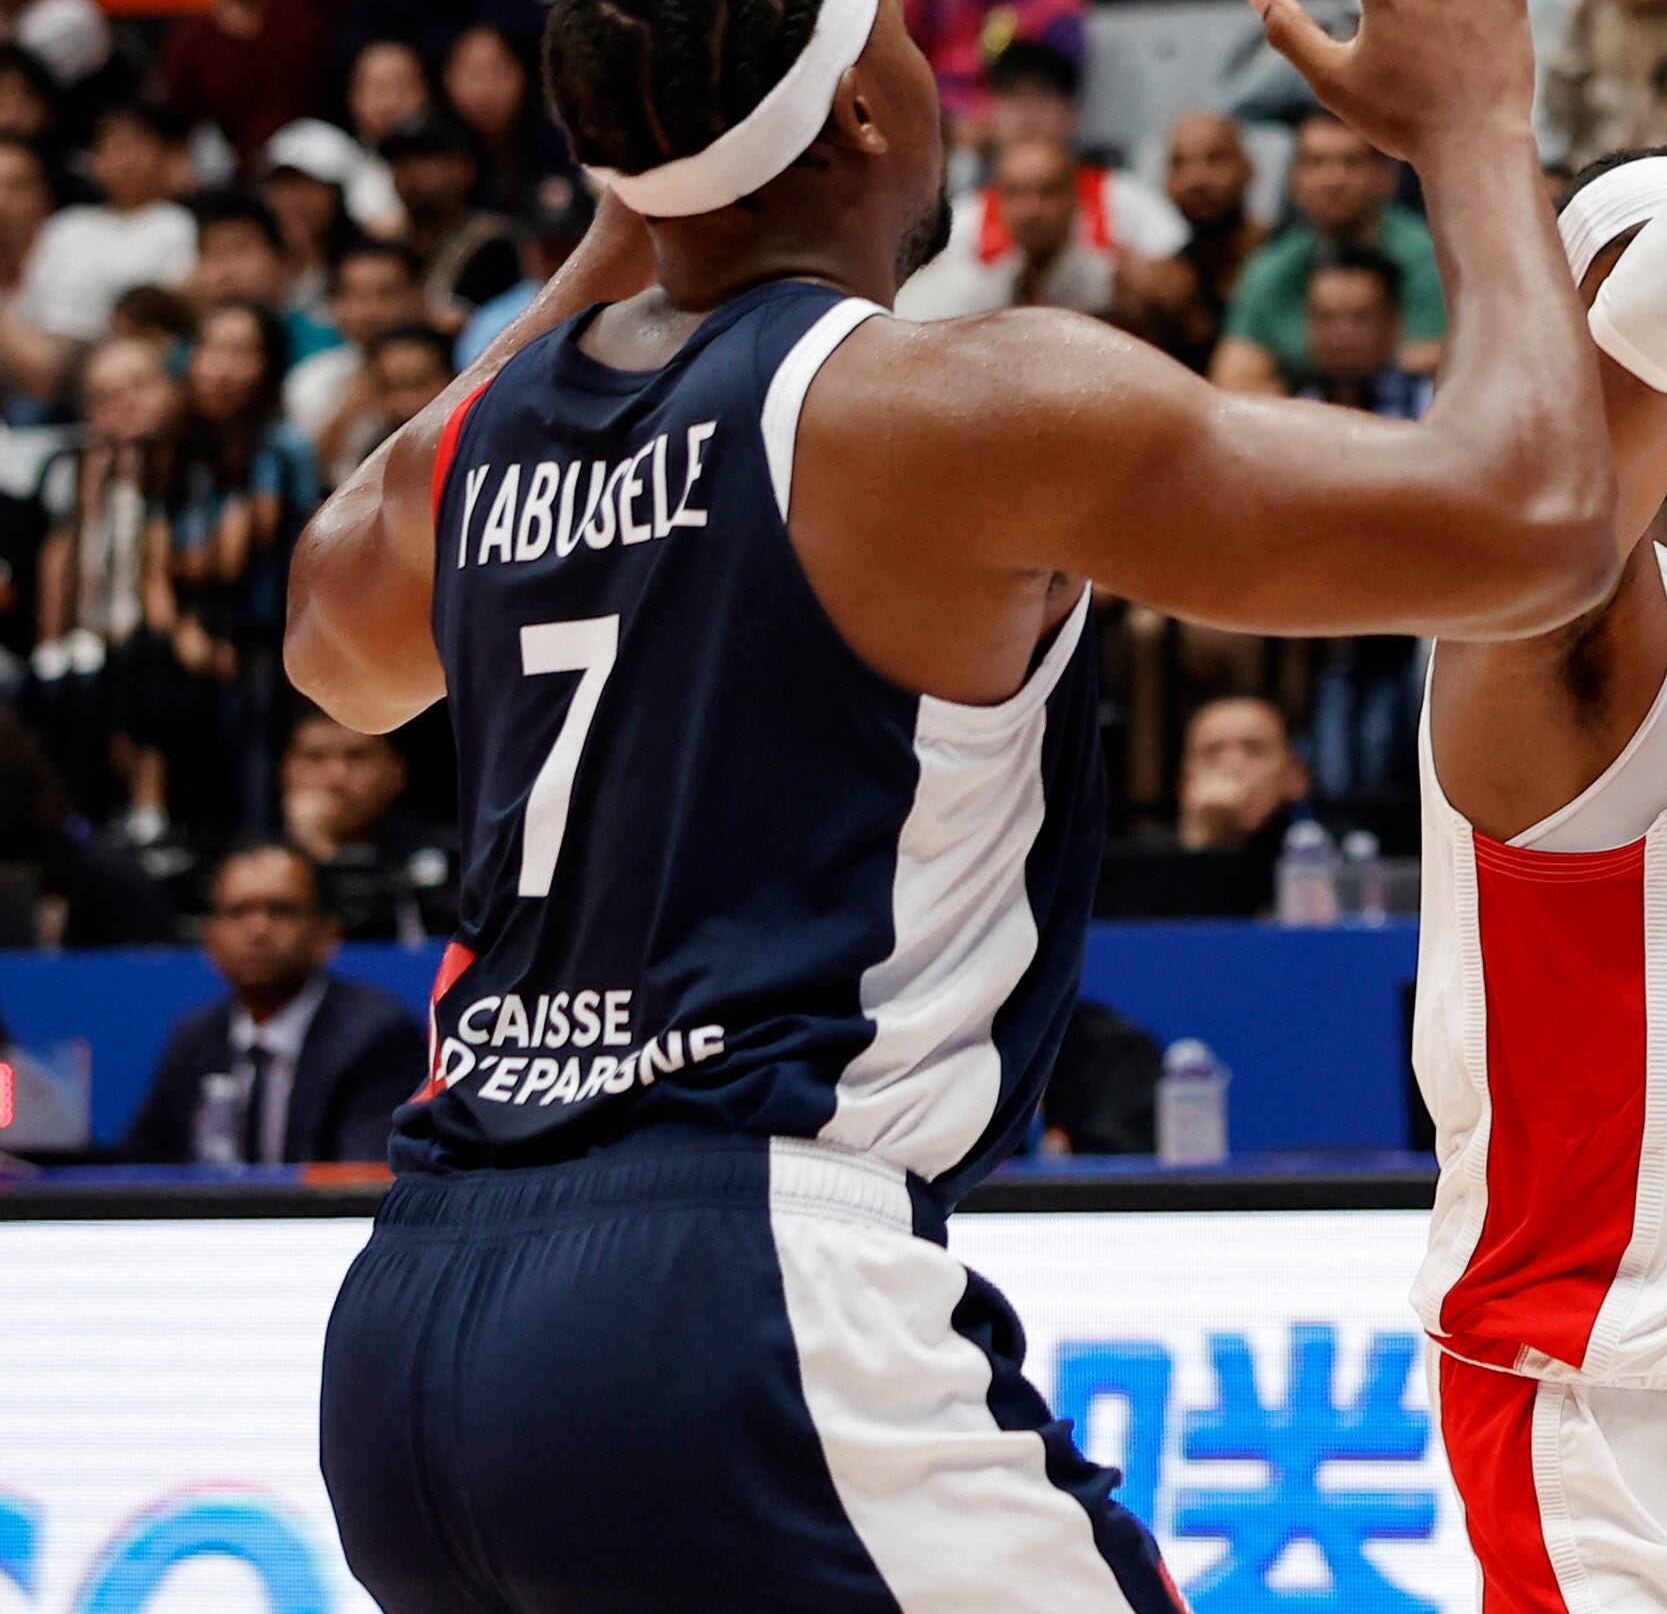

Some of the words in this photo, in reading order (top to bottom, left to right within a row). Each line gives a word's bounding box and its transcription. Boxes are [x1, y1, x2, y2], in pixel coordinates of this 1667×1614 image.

[457, 420, 718, 571] YABUSELE
[518, 613, 621, 899] 7
[458, 989, 634, 1049] CAISSE
